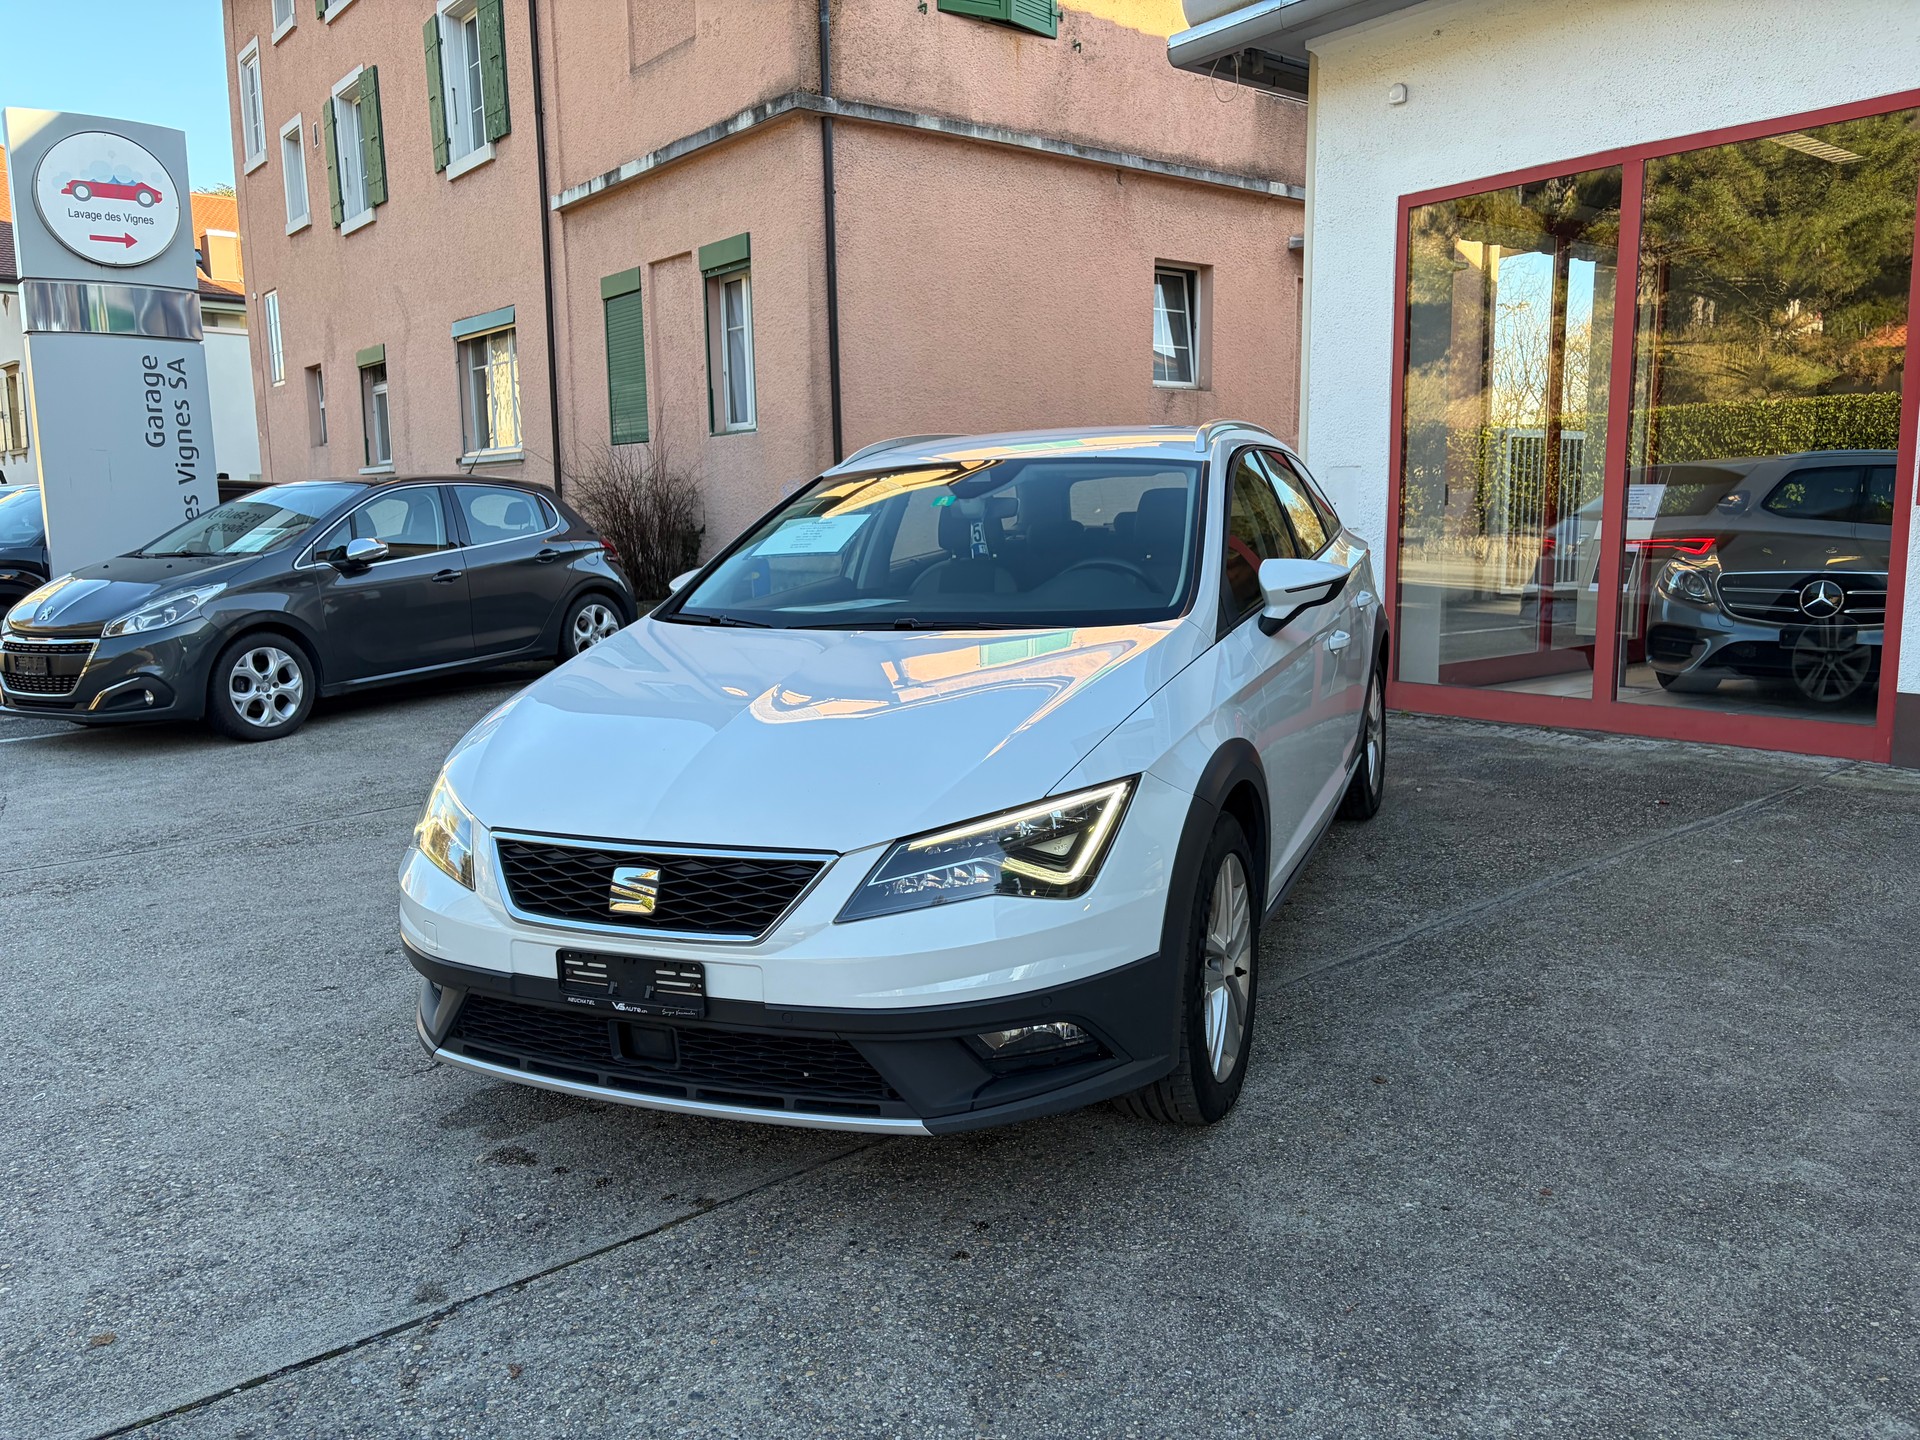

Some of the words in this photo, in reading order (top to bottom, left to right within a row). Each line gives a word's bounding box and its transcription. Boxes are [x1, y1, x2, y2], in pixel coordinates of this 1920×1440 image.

[67, 207, 102, 222] Lavage
[104, 211, 121, 222] des
[123, 213, 155, 226] Vignes
[167, 358, 188, 390] SA
[142, 355, 166, 448] Garage
[175, 399, 199, 486] Vignes
[183, 494, 200, 521] es
